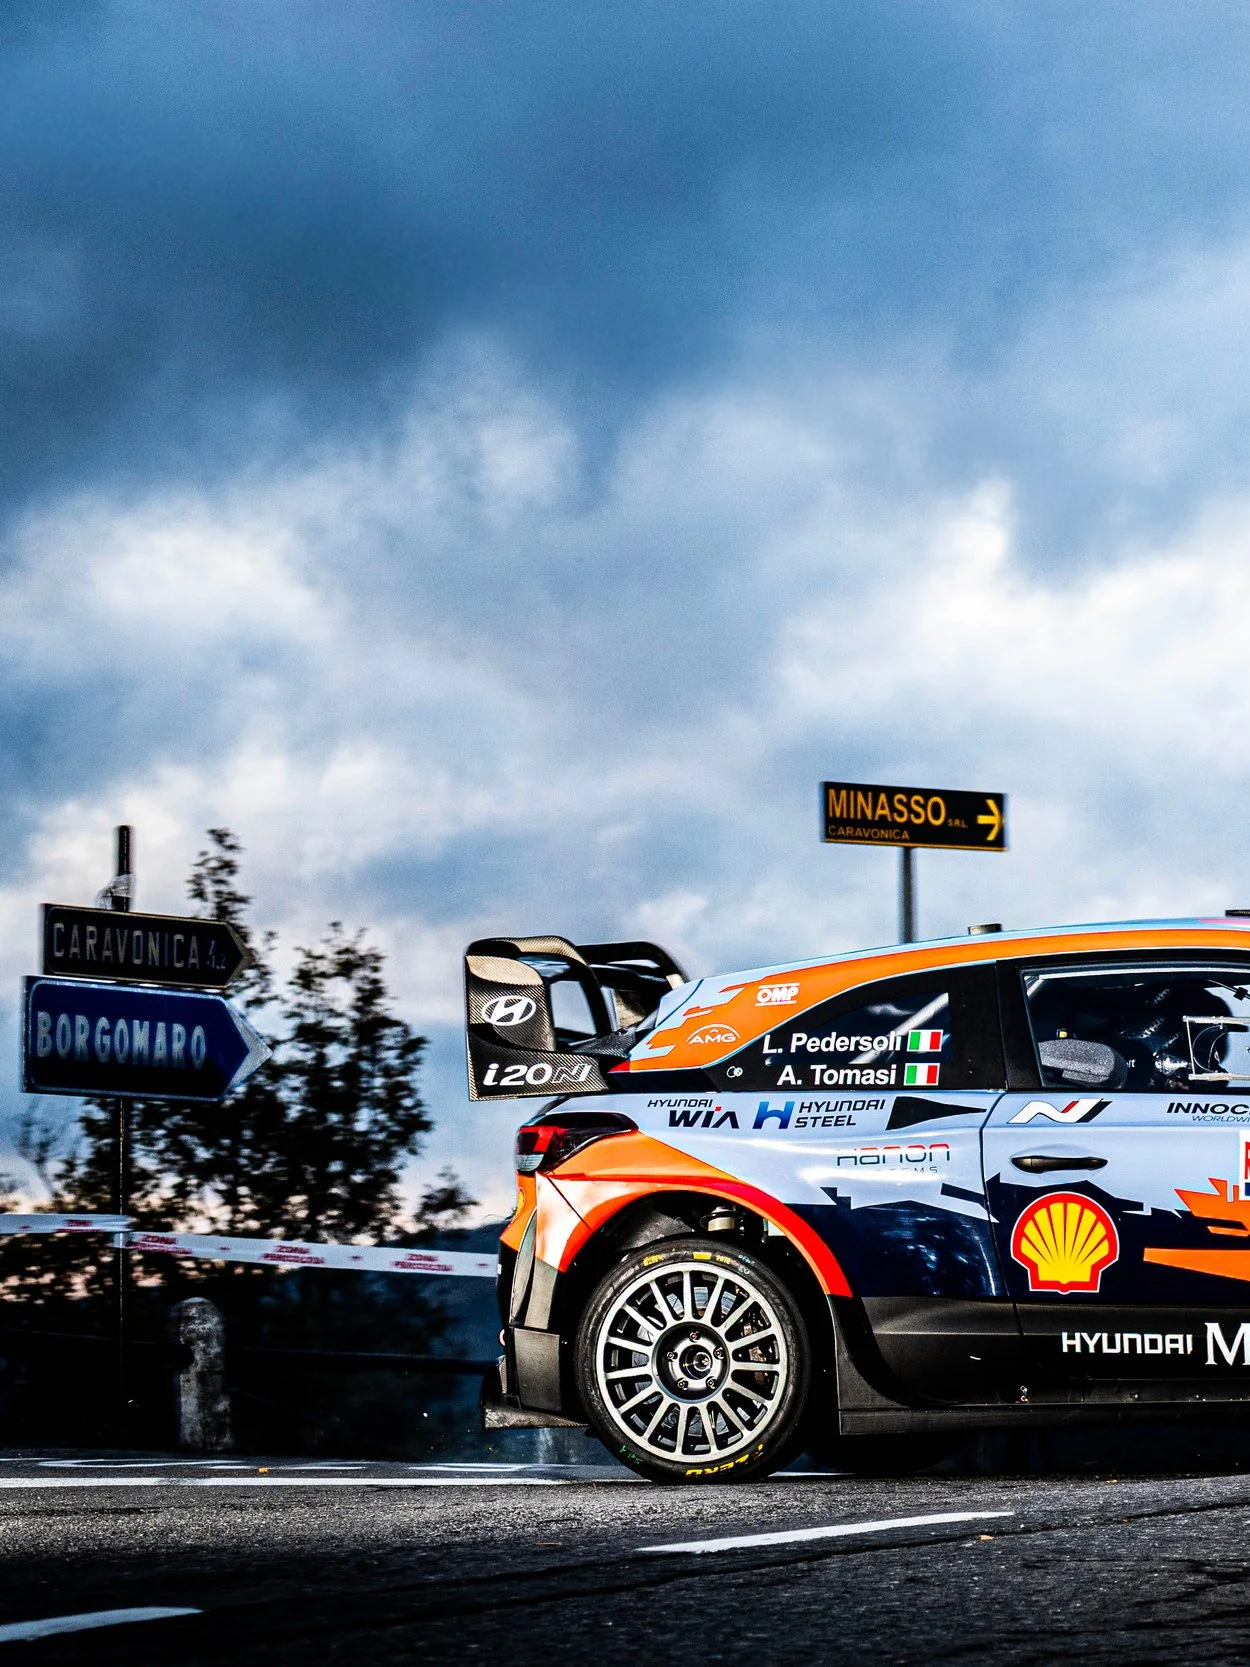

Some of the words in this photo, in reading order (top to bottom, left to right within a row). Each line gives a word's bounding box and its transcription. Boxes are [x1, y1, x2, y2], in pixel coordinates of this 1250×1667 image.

[828, 788, 946, 826] MINASSO
[828, 825, 910, 841] CARAVONICA
[53, 922, 200, 970] CARAVONICA
[756, 986, 799, 1003] OMP
[36, 1010, 207, 1069] BORGOMARO
[687, 1034, 737, 1045] AMG
[762, 1034, 783, 1054] L.
[790, 1031, 902, 1054] Pedersoli
[777, 1065, 802, 1085] A.
[812, 1064, 896, 1086] Tomasi
[647, 1099, 713, 1108] HYUNDAI
[799, 1099, 886, 1113] HYUNDAI
[668, 1106, 740, 1129] WIA
[794, 1115, 856, 1128] STEEL
[1061, 1332, 1193, 1355] HYUNDAI
